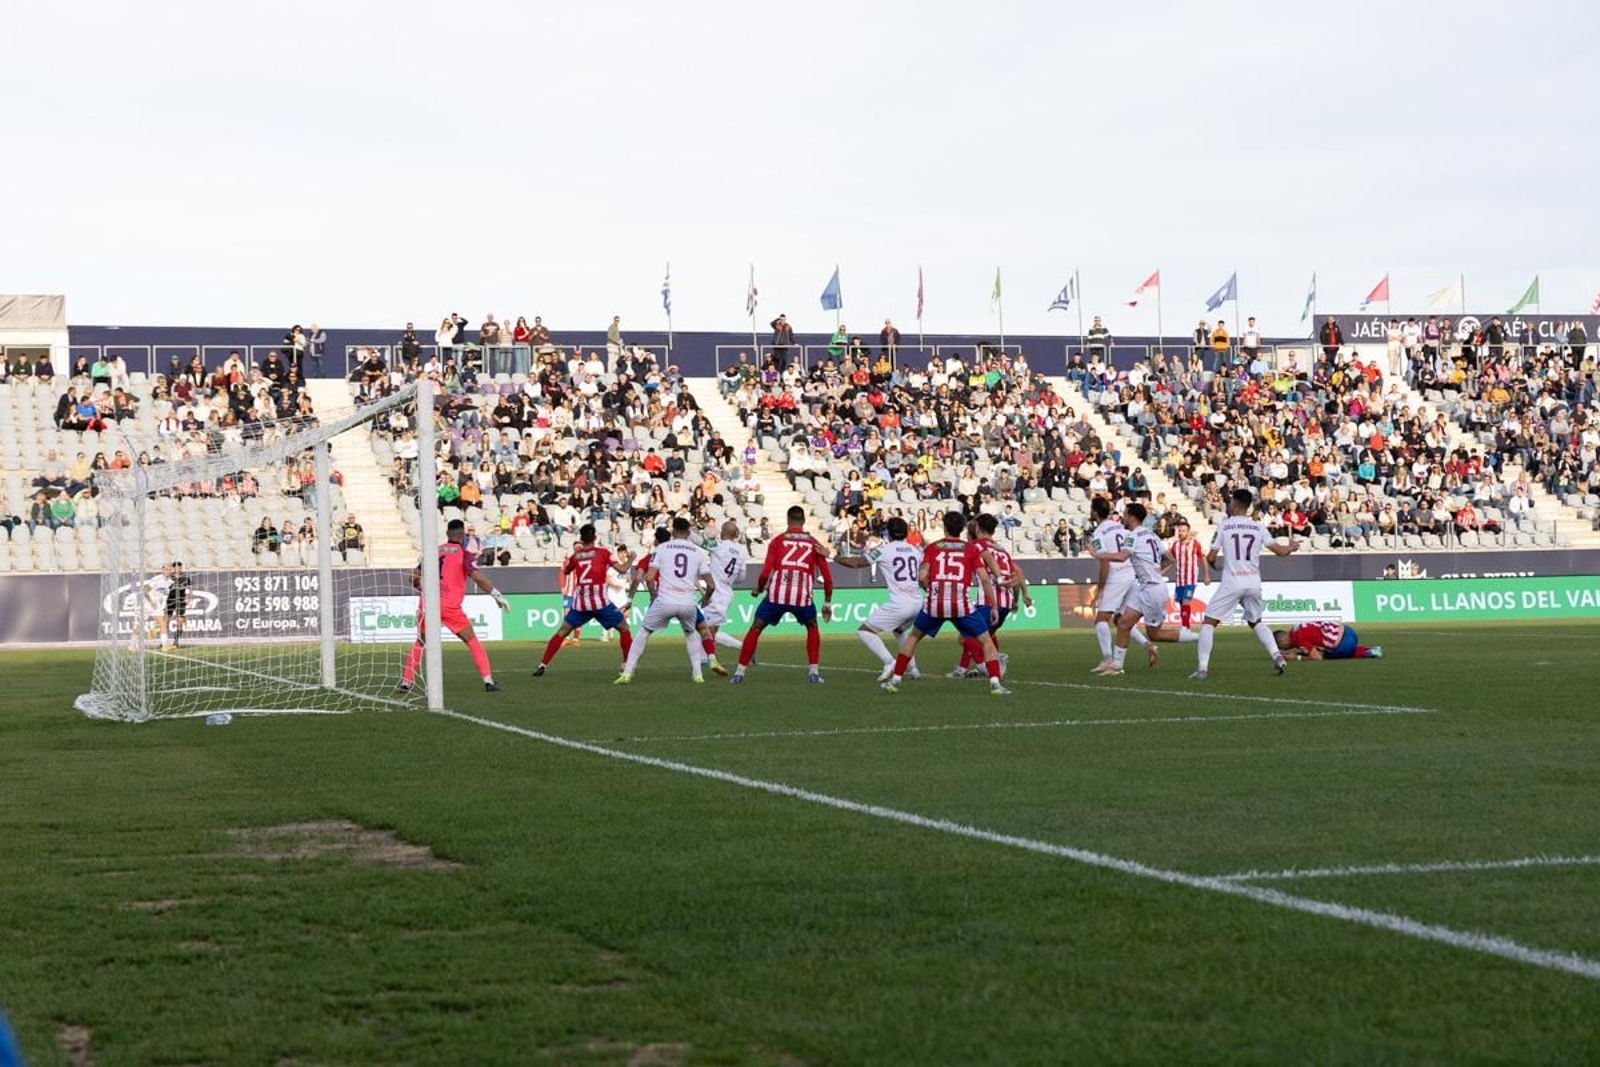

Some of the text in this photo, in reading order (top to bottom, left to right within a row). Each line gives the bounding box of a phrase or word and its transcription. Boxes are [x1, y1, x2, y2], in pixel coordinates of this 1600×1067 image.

[781, 540, 813, 568] 22
[1231, 533, 1255, 561] 17
[578, 560, 593, 584] 2
[674, 553, 688, 578] 9
[724, 557, 737, 578] 4
[893, 556, 918, 582] 20
[935, 551, 965, 581] 15
[234, 575, 318, 592] 953 871 104
[235, 596, 319, 612] 625 598 988
[1024, 602, 1037, 619] 6
[1376, 592, 1425, 612] POL.
[1431, 590, 1516, 611] LLANOS
[1522, 590, 1562, 609] DEL
[236, 618, 250, 629] C/
[252, 618, 300, 631] Europa,
